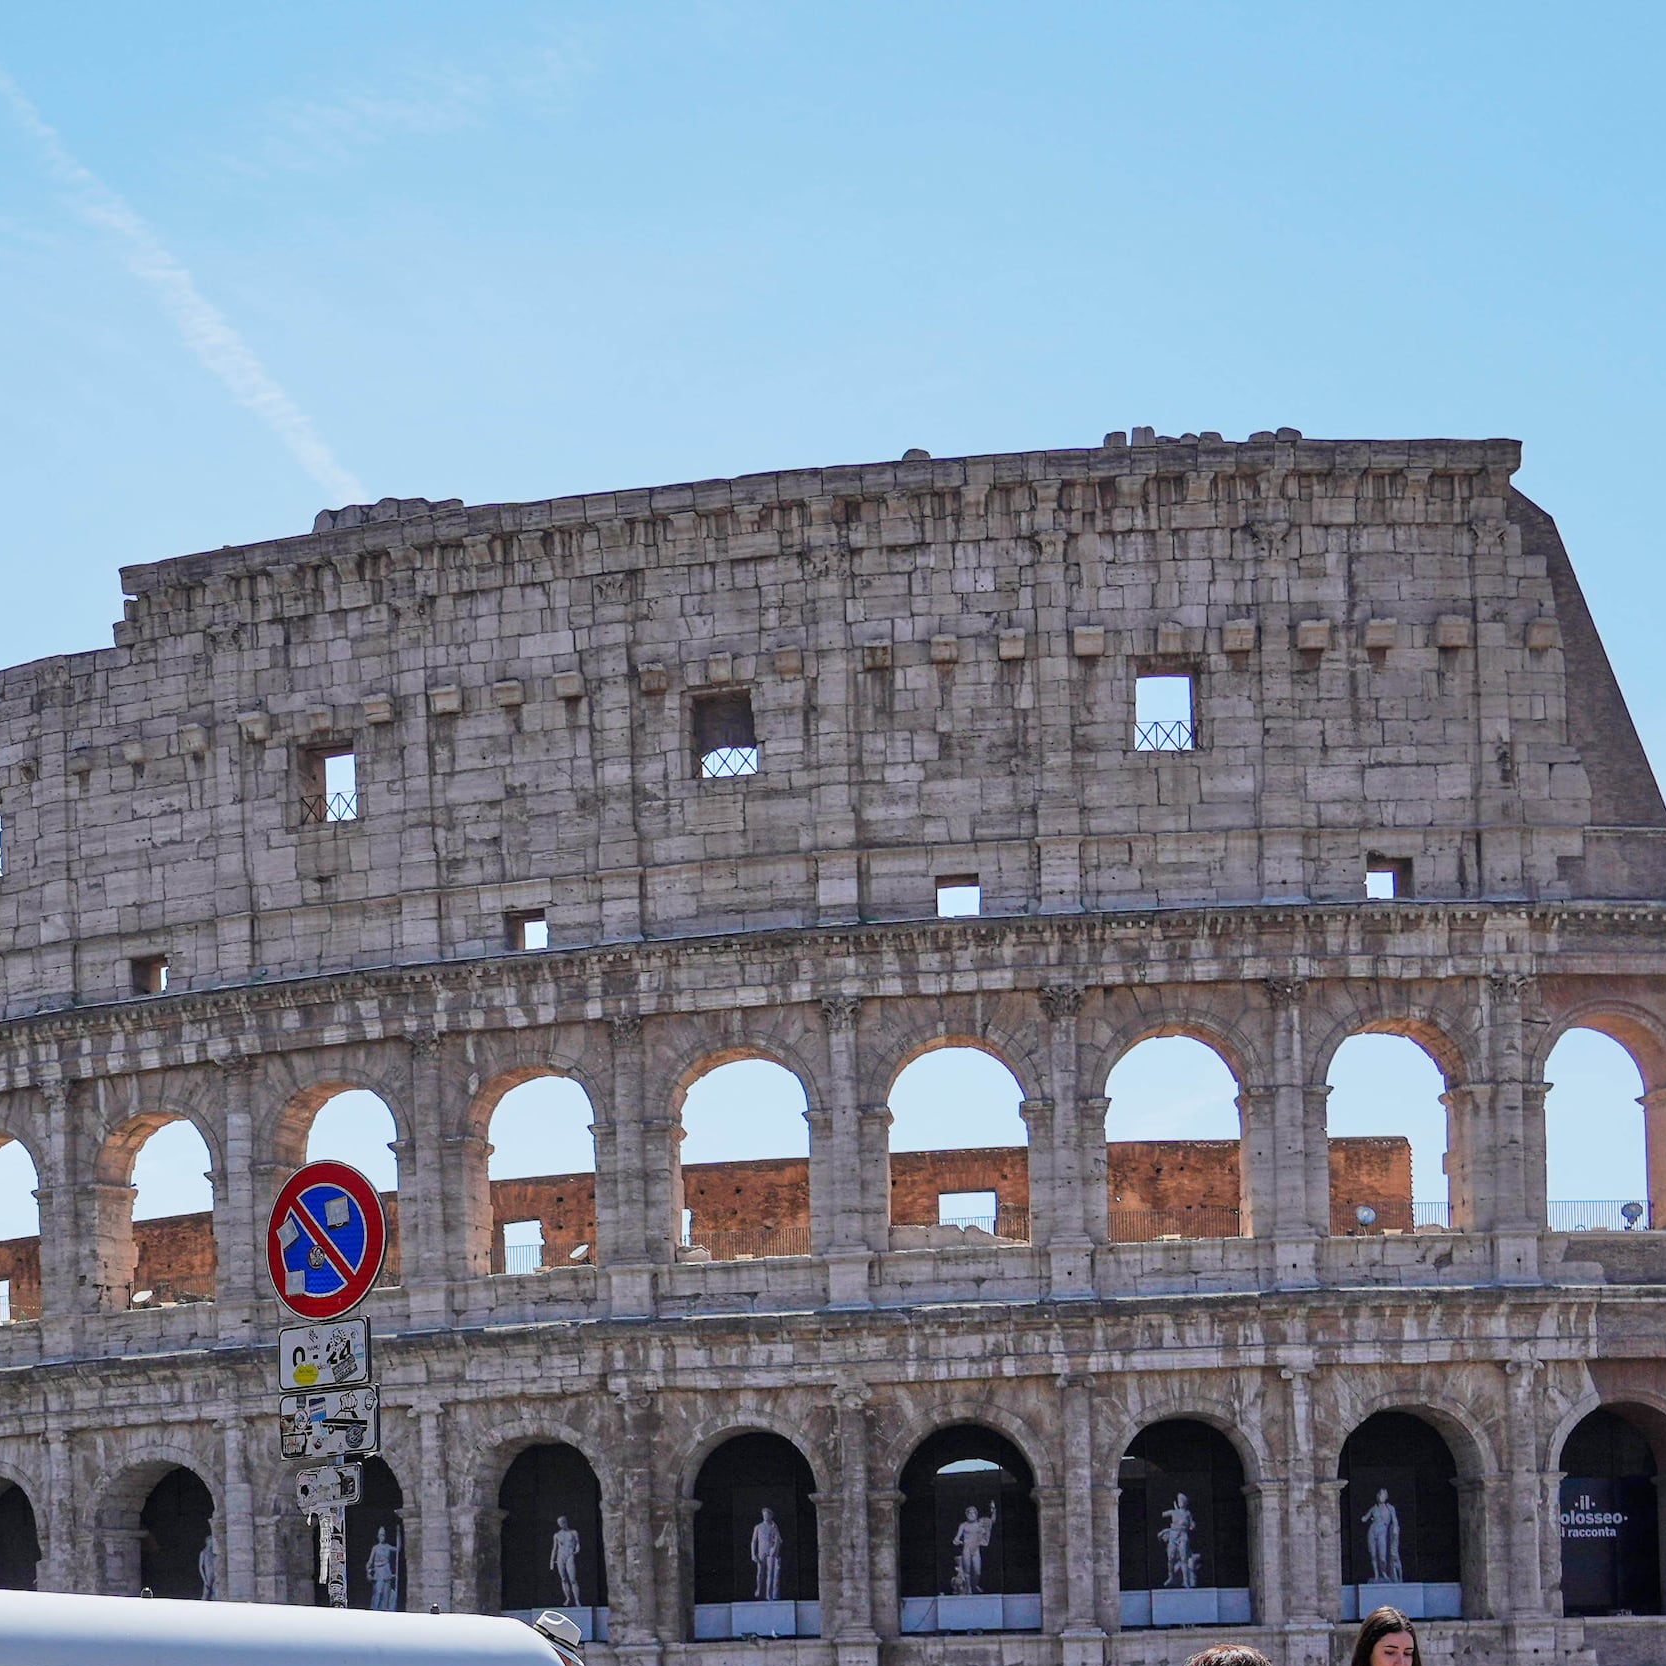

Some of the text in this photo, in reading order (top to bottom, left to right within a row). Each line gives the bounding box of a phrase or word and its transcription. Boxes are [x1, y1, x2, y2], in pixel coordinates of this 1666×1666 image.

[325, 1339, 351, 1365] 24
[1560, 1509, 1624, 1525] olosseo
[1567, 1526, 1617, 1538] racconta
